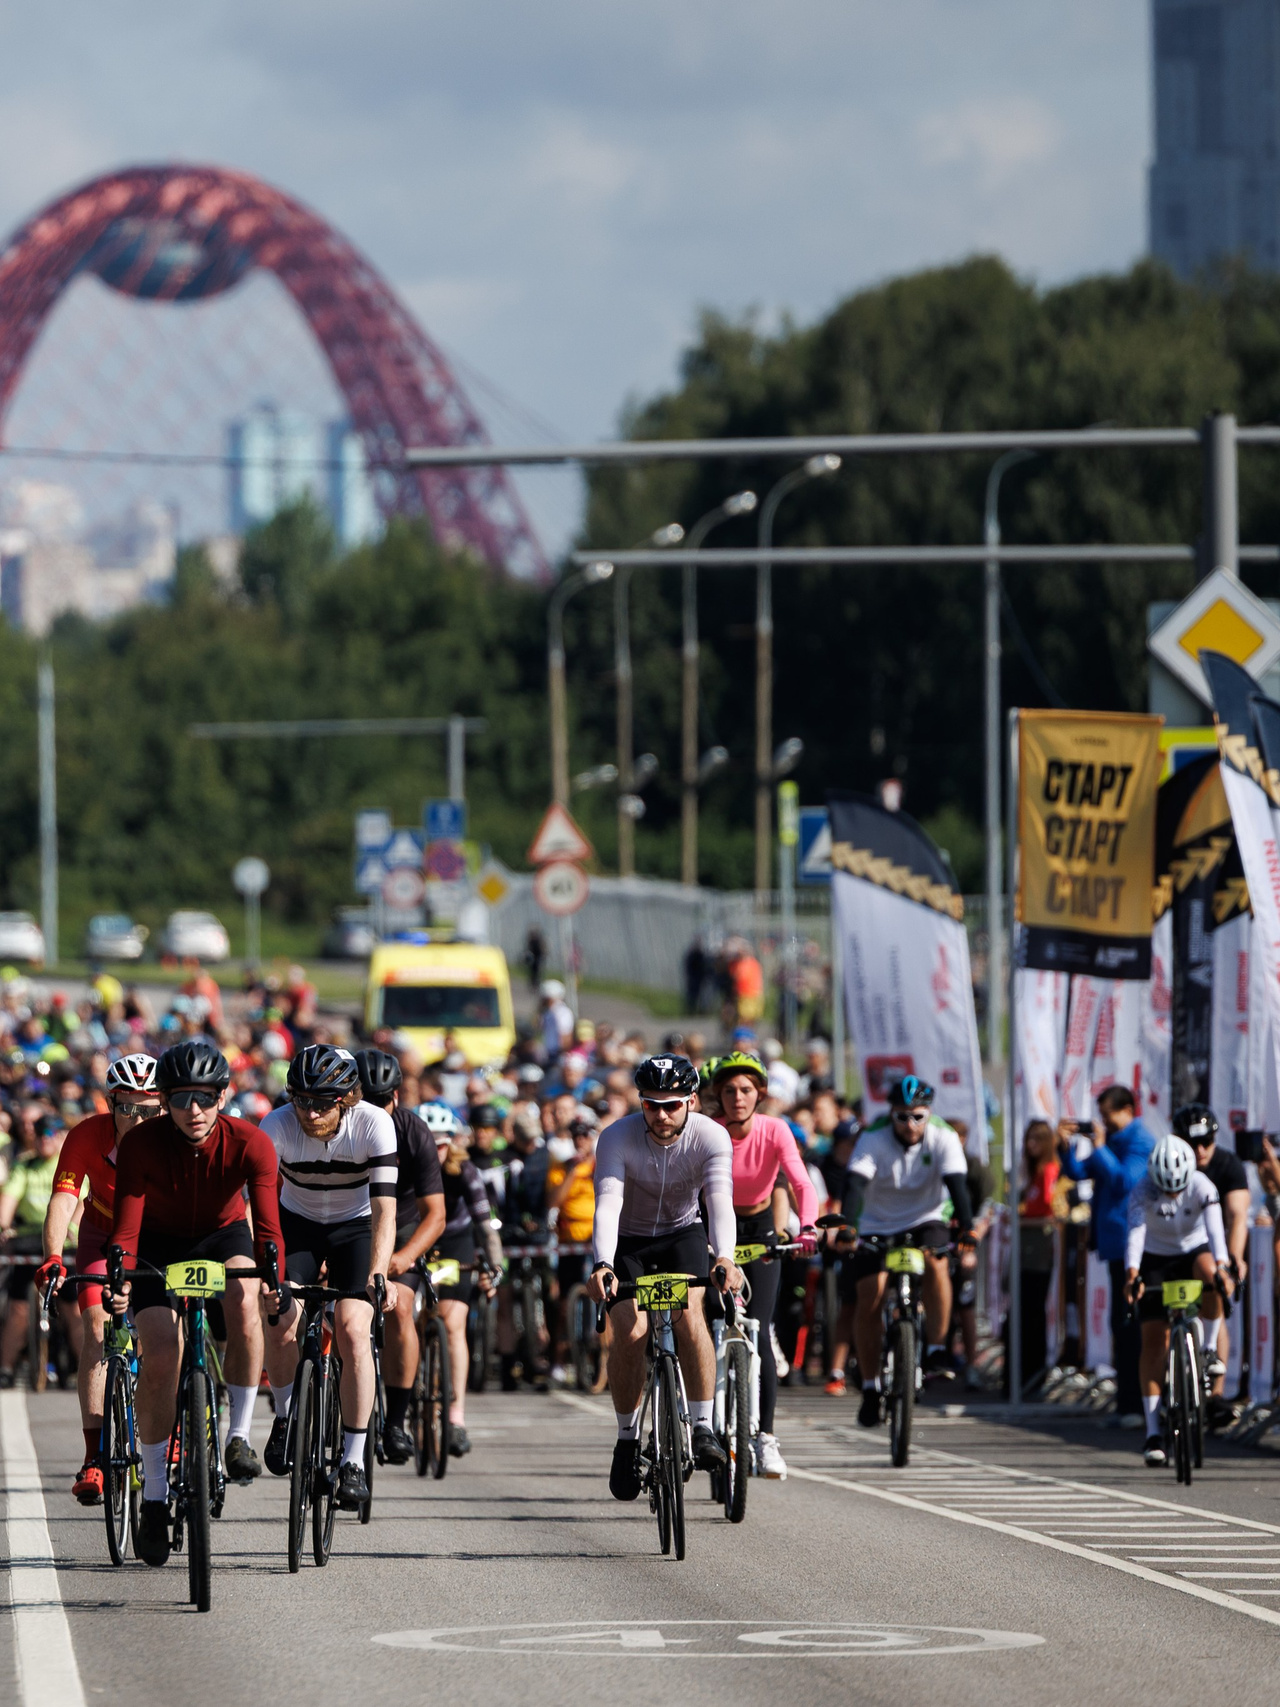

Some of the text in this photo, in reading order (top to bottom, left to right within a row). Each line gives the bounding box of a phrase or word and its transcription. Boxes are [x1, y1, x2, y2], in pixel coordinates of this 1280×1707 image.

[1042, 758, 1134, 809] СТАРТ
[1043, 812, 1128, 867] СТАРТ
[1044, 871, 1127, 921] СТАРТ
[734, 1249, 752, 1259] 26
[184, 1266, 208, 1287] 20
[653, 1280, 673, 1300] 33
[1179, 1286, 1187, 1300] 5
